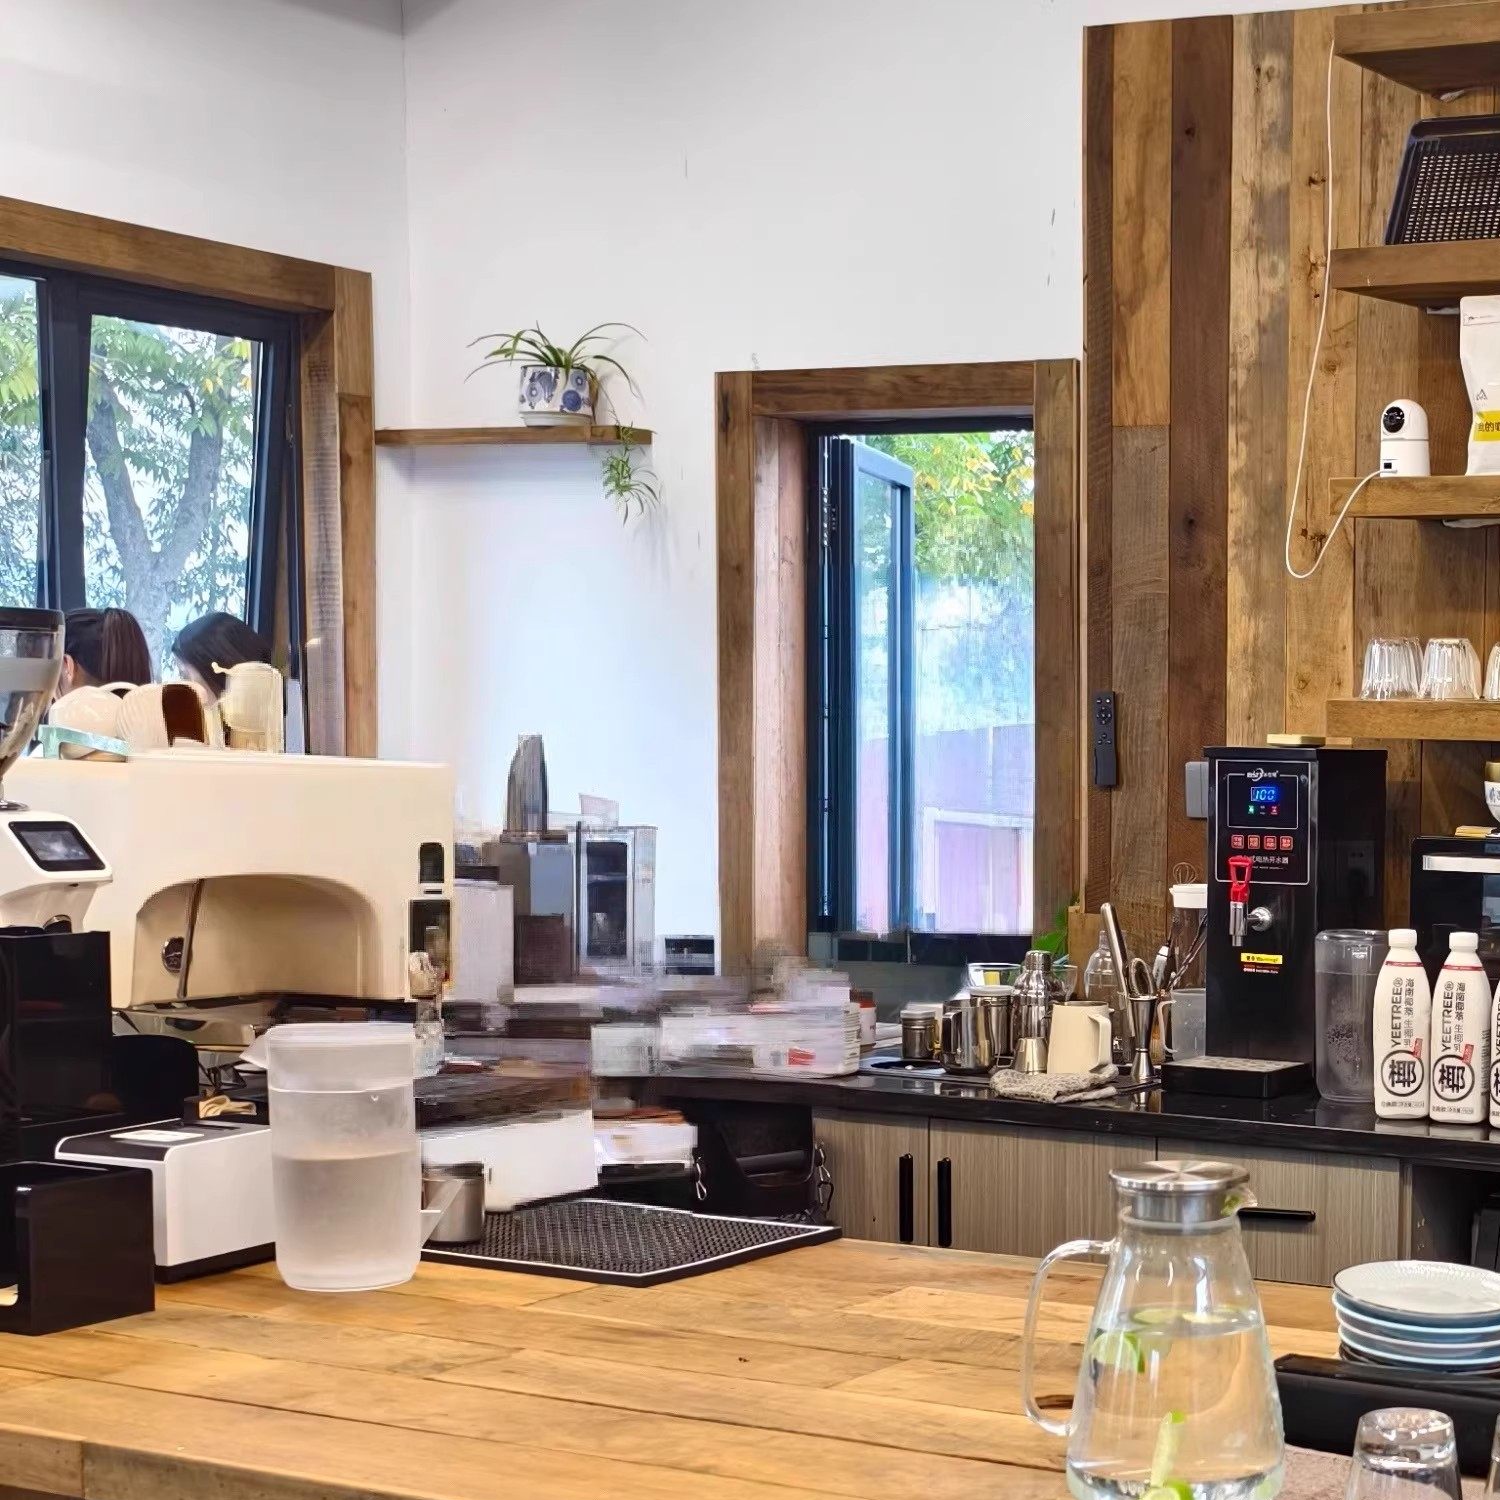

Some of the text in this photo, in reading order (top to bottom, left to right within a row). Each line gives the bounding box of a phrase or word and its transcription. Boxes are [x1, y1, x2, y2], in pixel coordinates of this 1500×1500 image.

[1256, 789, 1275, 801] 100
[1388, 1059, 1417, 1088] 椰
[1438, 1064, 1466, 1093] 椰
